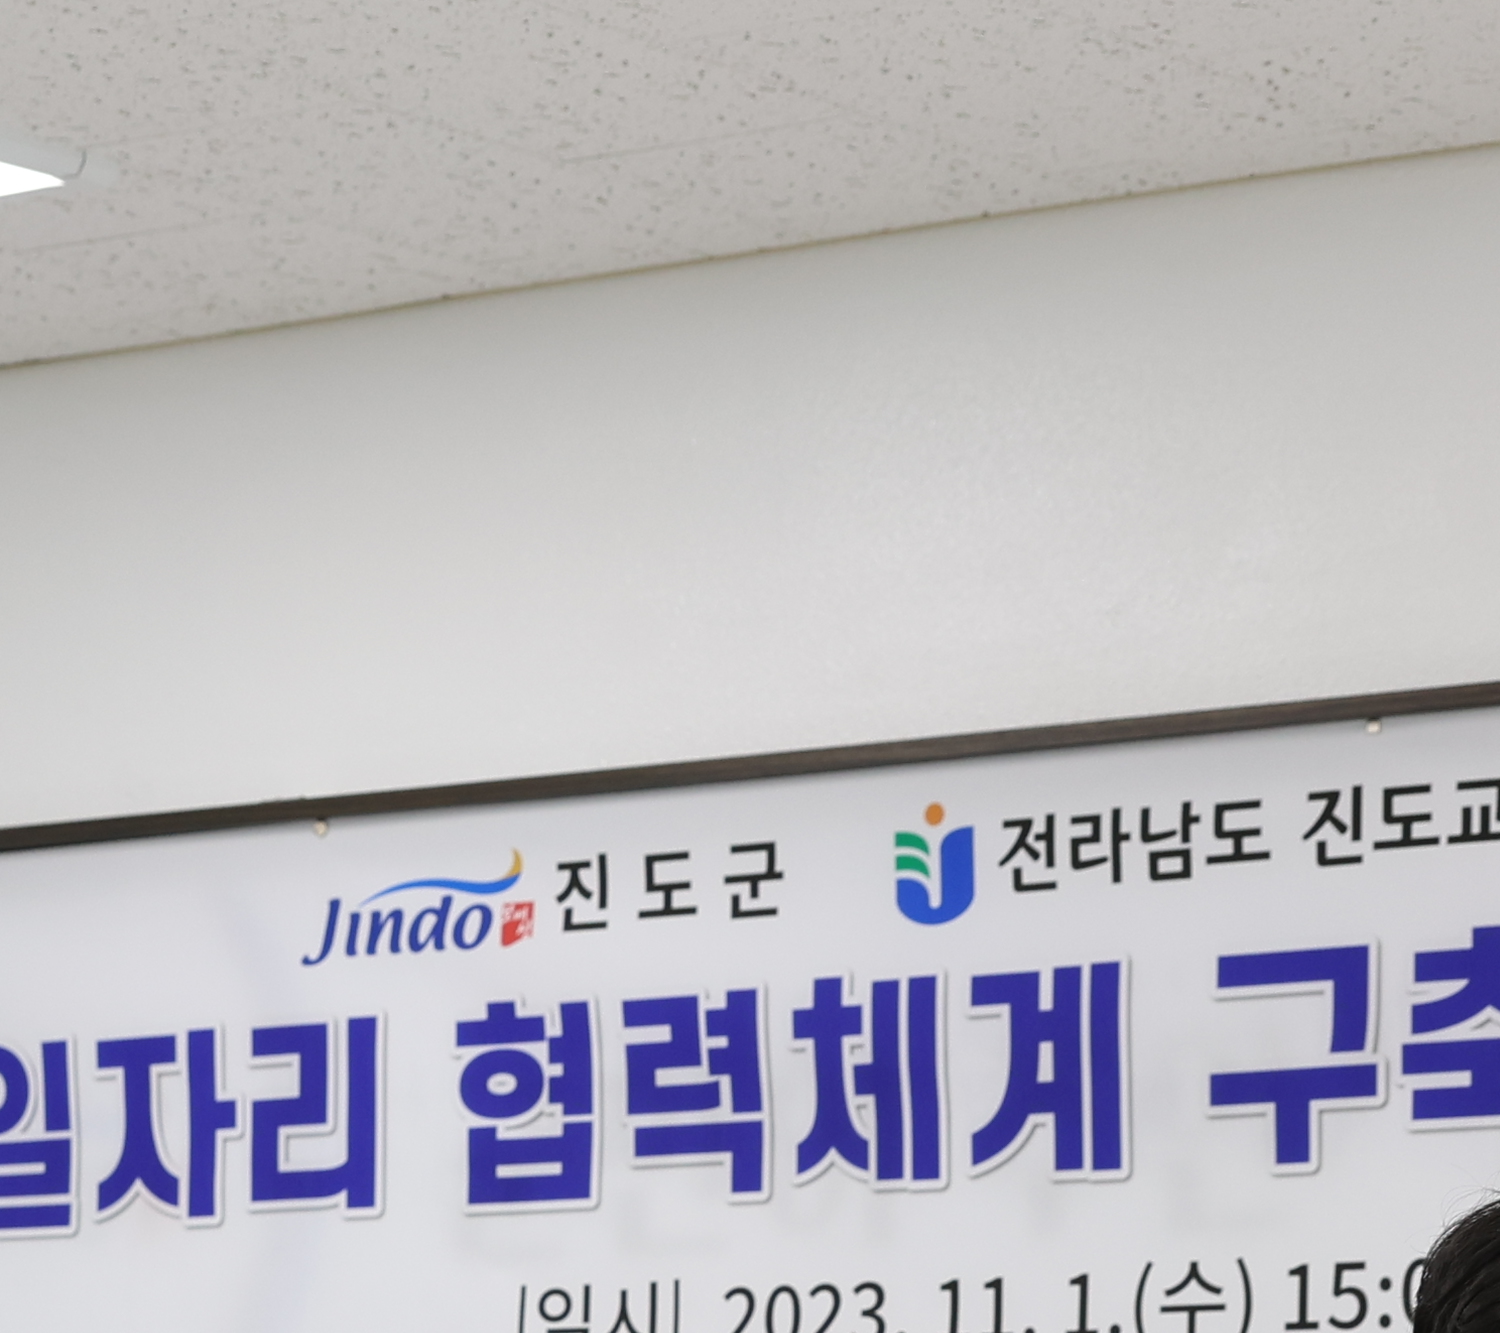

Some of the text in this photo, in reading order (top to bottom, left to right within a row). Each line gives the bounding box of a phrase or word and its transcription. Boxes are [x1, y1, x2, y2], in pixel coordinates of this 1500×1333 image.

[998, 799, 1272, 893] 전라남도
[300, 893, 495, 967] Jindo
[455, 959, 1123, 1207] 협력체계
